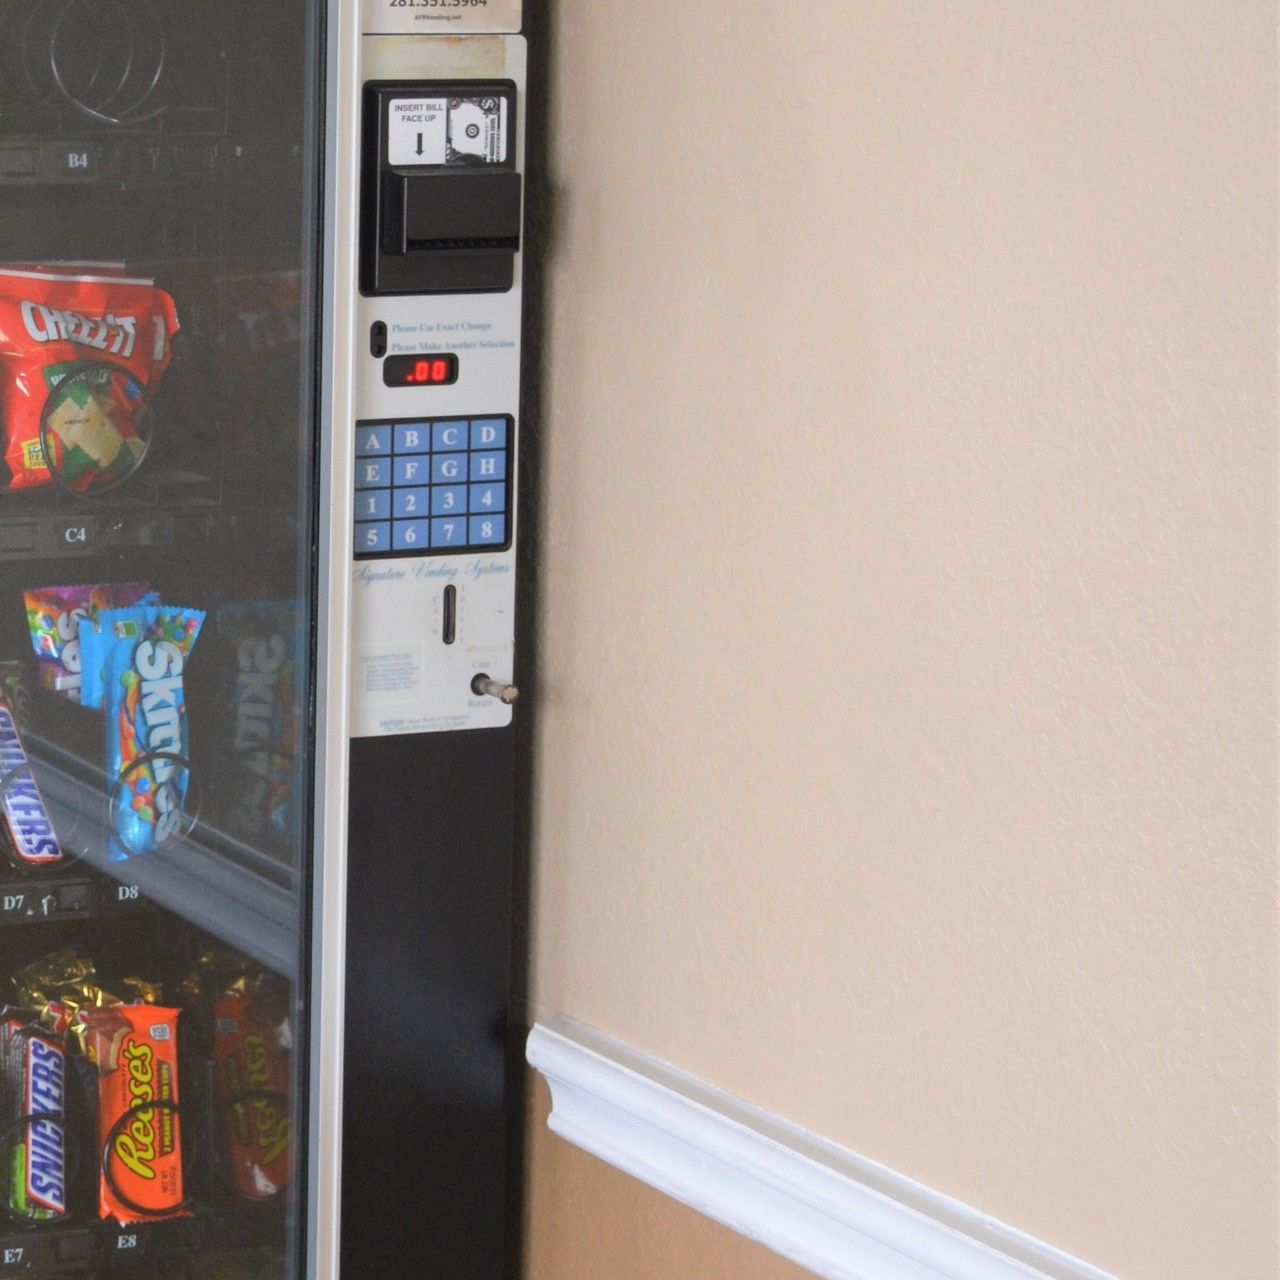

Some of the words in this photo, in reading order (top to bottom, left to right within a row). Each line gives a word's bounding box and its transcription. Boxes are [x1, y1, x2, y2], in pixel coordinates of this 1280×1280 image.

[395, 104, 424, 112] INSERT
[426, 103, 444, 111] BILL
[68, 153, 88, 168] B4
[392, 324, 417, 332] Please
[420, 324, 433, 332] Use
[436, 323, 459, 331] Exact
[461, 322, 492, 332] Change
[392, 343, 416, 352] Please
[420, 343, 441, 351] Make
[445, 341, 476, 350] Another
[479, 340, 515, 349] Selection
[366, 433, 381, 449] A
[405, 430, 419, 447] B
[442, 428, 458, 445] C
[481, 426, 496, 443] D
[366, 465, 379, 481] E
[405, 462, 418, 479] F
[441, 460, 457, 477] G
[480, 458, 495, 475] H
[368, 497, 376, 513] 1
[405, 494, 416, 512] 2
[443, 492, 454, 509] 3
[481, 490, 493, 506] 4
[65, 527, 86, 542] C4
[367, 529, 378, 546] 5
[404, 527, 417, 543] 6
[443, 523, 454, 540] 7
[481, 521, 493, 538] 8
[354, 566, 406, 585] Signature
[413, 562, 458, 581] Vending
[465, 559, 510, 580] Systems
[118, 885, 139, 900] D8
[4, 894, 25, 910] D7
[115, 1040, 155, 1179] Reese's
[30, 1042, 64, 1210] SNICKERS
[117, 1235, 137, 1249] E8
[4, 1247, 24, 1263] E7
